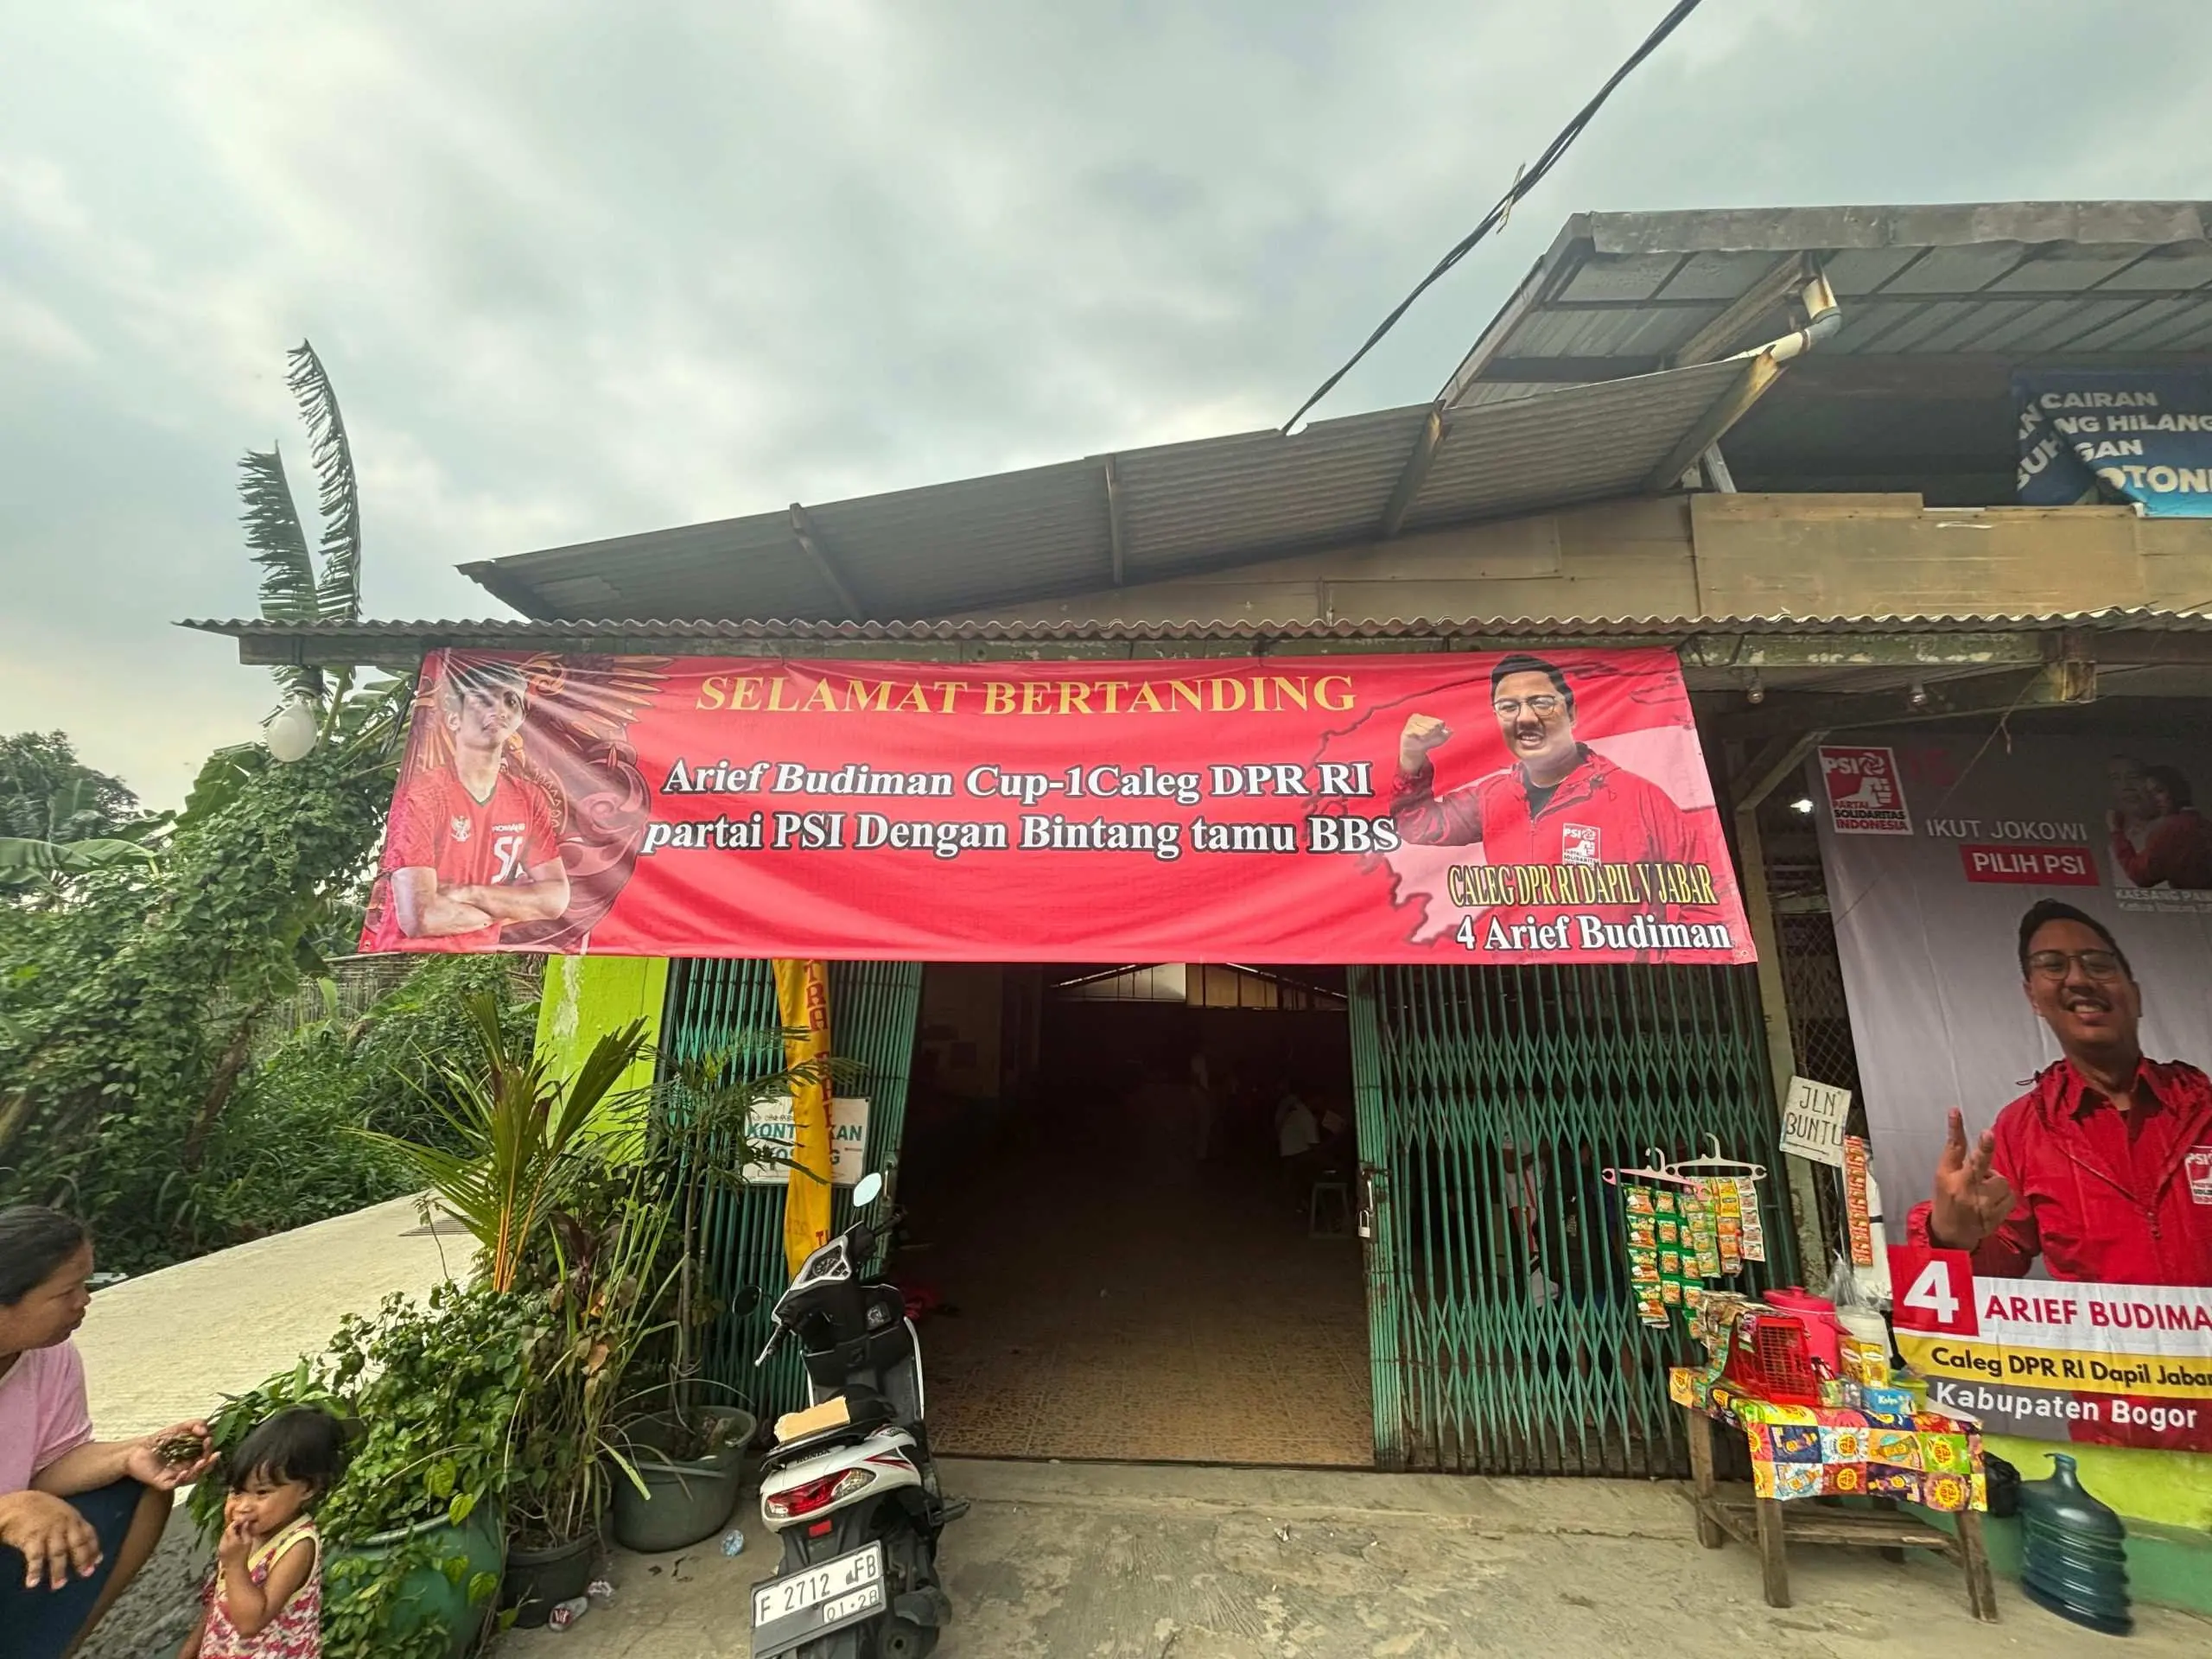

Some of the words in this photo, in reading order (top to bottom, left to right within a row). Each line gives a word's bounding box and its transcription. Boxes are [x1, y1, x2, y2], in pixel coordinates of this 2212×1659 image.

[2040, 392, 2158, 410] CAIRAN
[696, 676, 968, 715] SELAMAT
[982, 675, 1357, 715] BERTANDING
[663, 759, 771, 793] Arief
[772, 762, 952, 797] Budiman
[1210, 764, 1310, 797] DPR
[1318, 762, 1374, 796] RI
[1821, 757, 1860, 774] PSI
[1834, 810, 1906, 820] SOLIDARITAS
[1836, 819, 1910, 831] INDONESIA
[1926, 819, 1981, 838] IKUT
[1991, 821, 2088, 841] JOKOWI
[640, 813, 763, 854] partai
[773, 813, 846, 849] PSI
[855, 814, 1007, 857] Dengan
[1020, 815, 1182, 858] Bintang
[1191, 817, 1298, 851] tamu
[1308, 816, 1400, 852] BBS
[1972, 853, 2040, 874] PILIH
[2044, 855, 2087, 874] PSI
[1448, 865, 1514, 906] CALEG
[1516, 864, 1556, 906] DPR
[1554, 864, 1580, 905] RI
[1580, 864, 1641, 905] DAPIL
[1636, 864, 1651, 904] V
[1657, 864, 1719, 906] JABAR
[1456, 914, 1476, 950] 4
[1484, 914, 1570, 950] Arief
[1575, 914, 1734, 950] Budiman
[1799, 1085, 1837, 1116] JLN
[746, 1122, 862, 1141] KONTKAN
[1785, 1112, 1845, 1146] BUNTU
[1904, 1260, 1959, 1324] 4
[1984, 1294, 2077, 1325] ARIEF
[1931, 1346, 2002, 1376] Caleg
[2009, 1354, 2058, 1378] DPR
[2063, 1359, 2084, 1379] RI
[2091, 1361, 2151, 1388] Dapil
[1936, 1382, 2100, 1421] Kabupaten
[2112, 1400, 2198, 1432] Bogor
[760, 1595, 771, 1622] F
[784, 1573, 830, 1611] 2712
